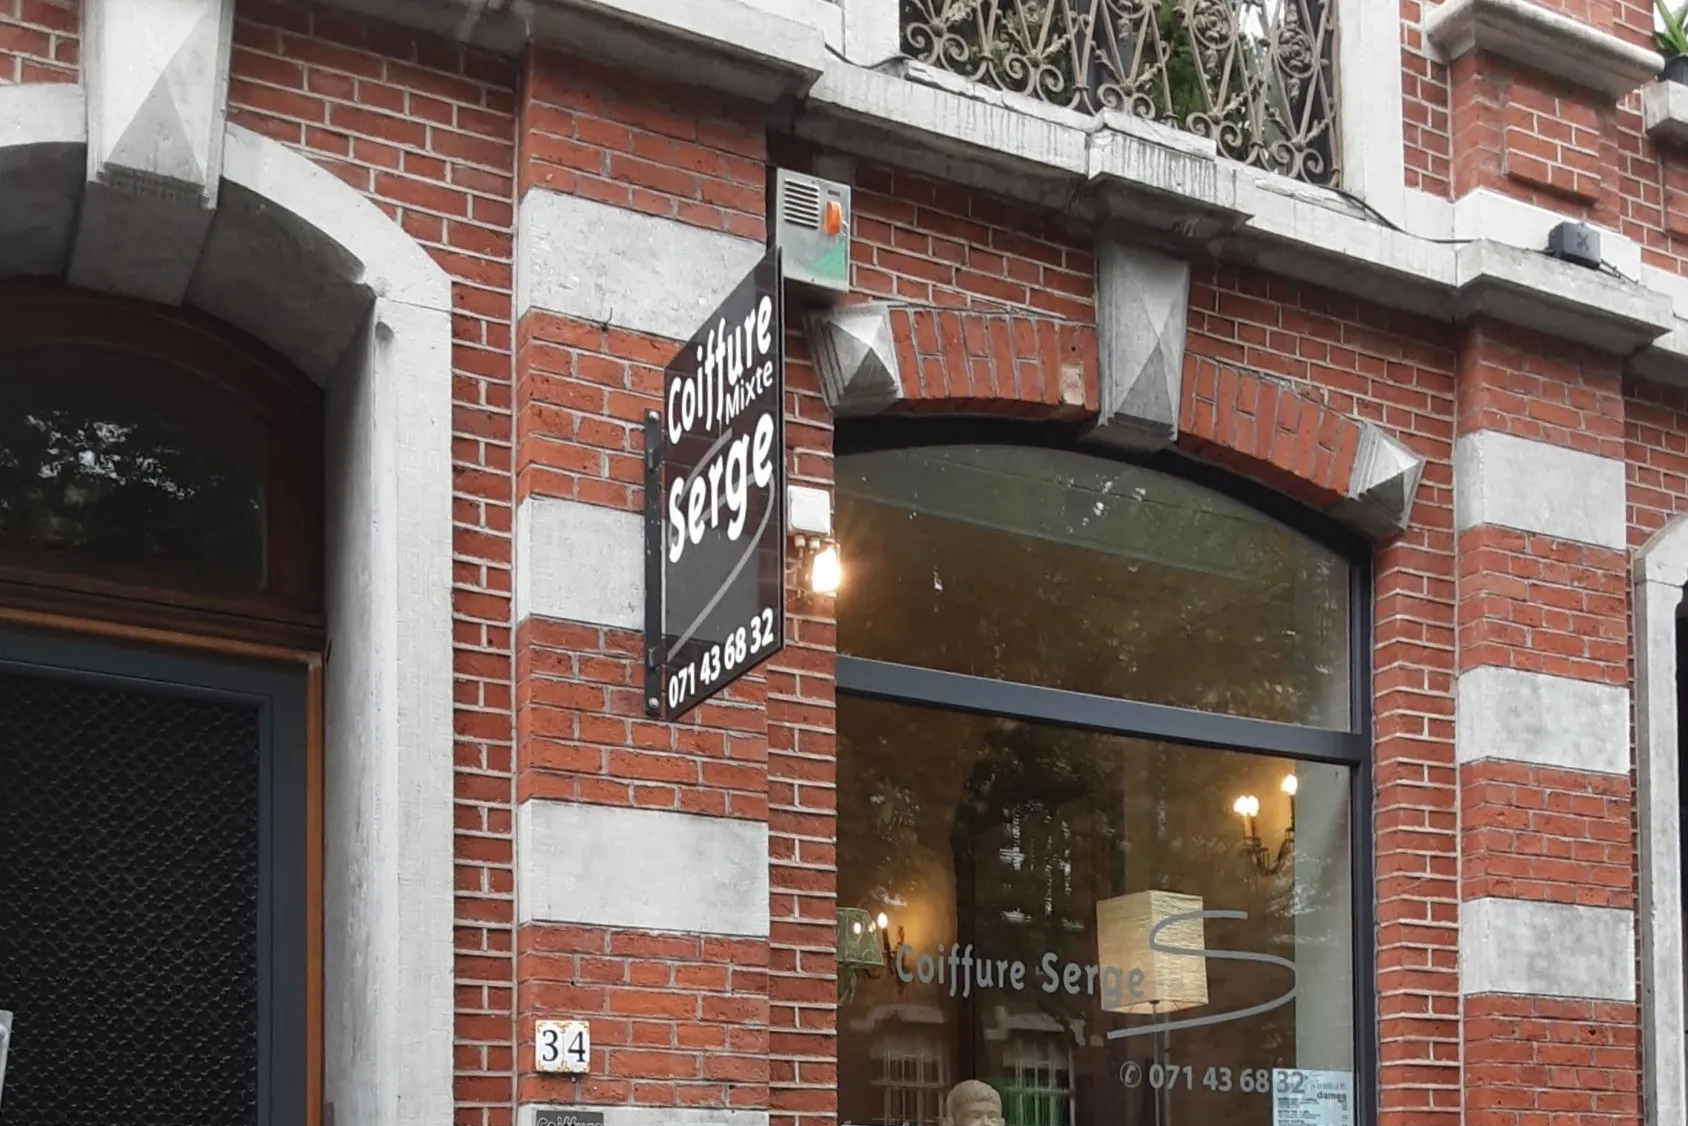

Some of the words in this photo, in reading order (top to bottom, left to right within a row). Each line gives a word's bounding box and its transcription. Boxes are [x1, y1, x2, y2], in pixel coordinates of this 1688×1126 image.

[668, 295, 772, 444] Coiffure
[725, 361, 773, 425] Mixte
[668, 412, 774, 564] Serge
[669, 662, 695, 708] 071
[700, 644, 720, 685] 43
[724, 627, 746, 670] 68
[750, 607, 774, 654] 32
[895, 943, 1026, 998] Coiffure
[1041, 952, 1145, 1009] Serge
[542, 1029, 586, 1063] 34
[1149, 1063, 1193, 1091] 071
[1202, 1067, 1233, 1092] 43
[1239, 1068, 1270, 1093] 68
[1276, 1070, 1306, 1094] 32
